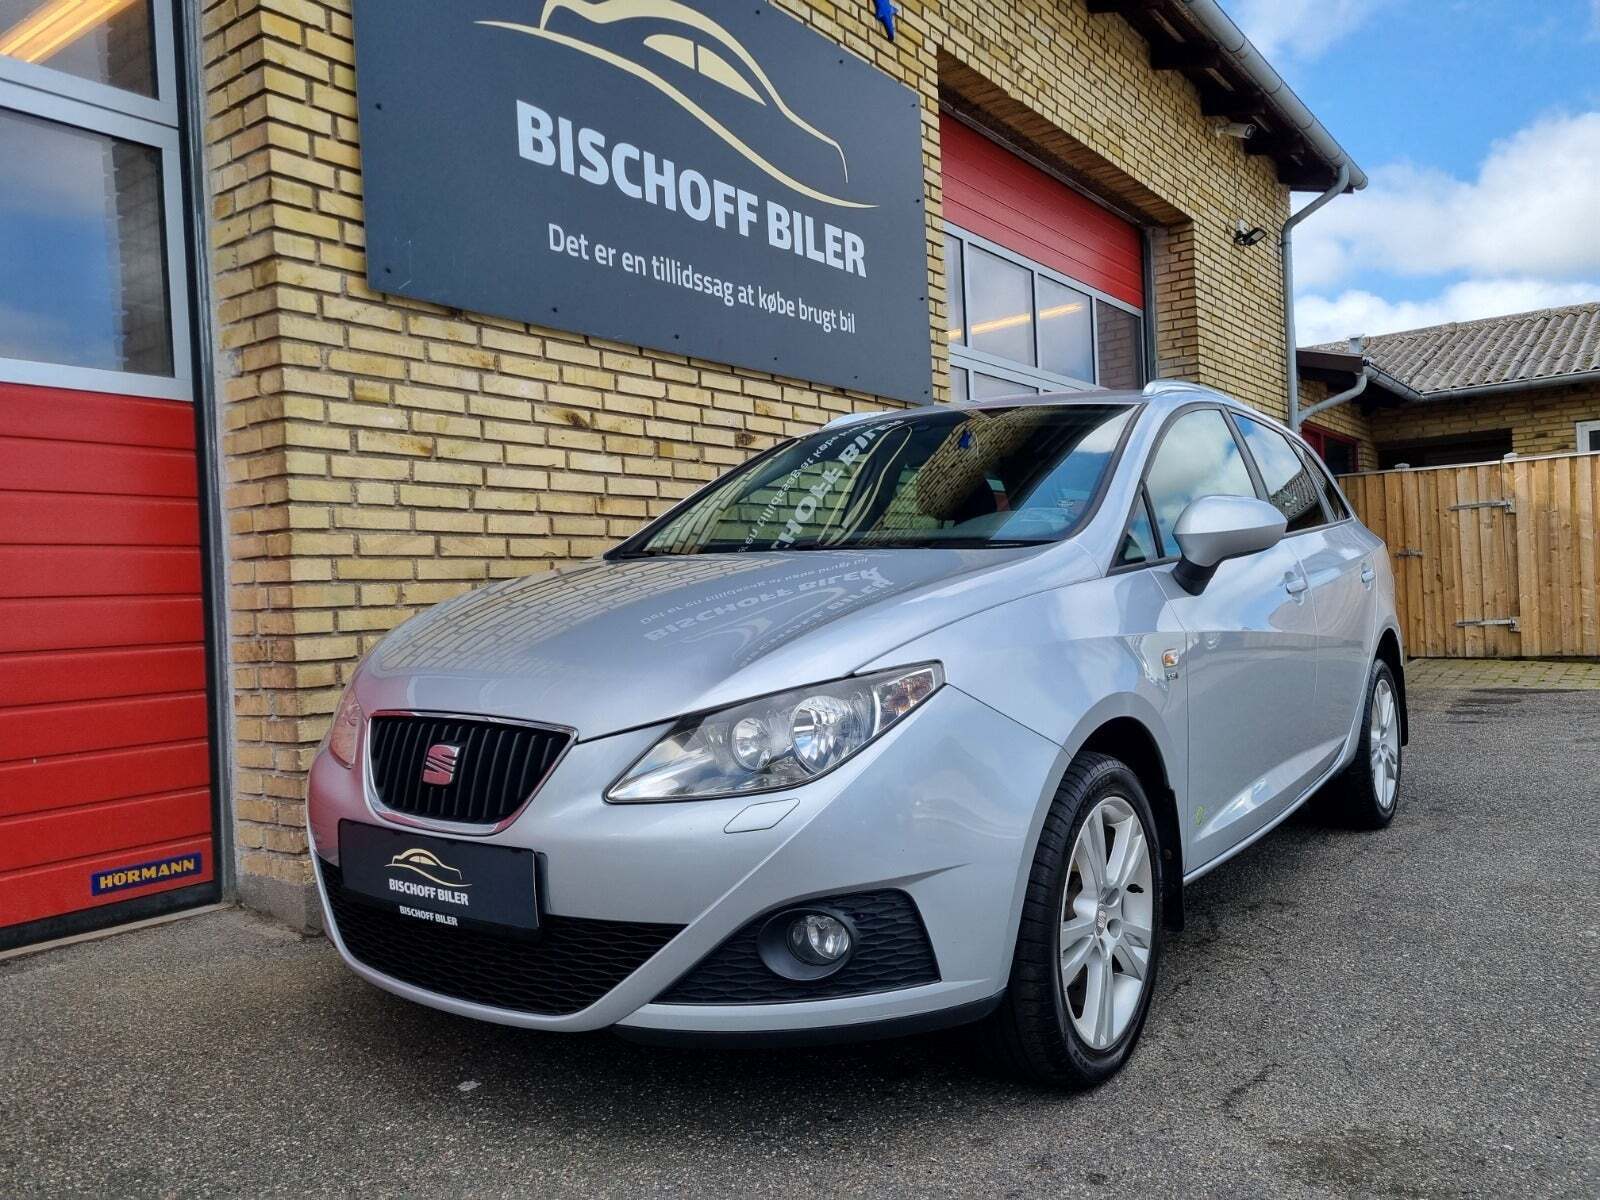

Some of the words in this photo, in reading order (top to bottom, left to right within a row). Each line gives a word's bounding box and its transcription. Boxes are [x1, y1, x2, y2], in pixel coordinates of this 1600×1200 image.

[516, 99, 758, 237] BISCHOFF
[766, 200, 867, 278] BILER
[548, 223, 589, 261] Det
[594, 238, 616, 266] er
[622, 245, 647, 276] en
[651, 255, 734, 305] tillidssag
[738, 280, 755, 306] at
[758, 286, 796, 319] købe
[798, 301, 838, 334] brugt
[839, 311, 856, 334] bil
[388, 878, 437, 899] BISCHOFF
[437, 888, 469, 906] BILER
[399, 905, 435, 921] BISCHOFF
[435, 913, 458, 926] BILER
